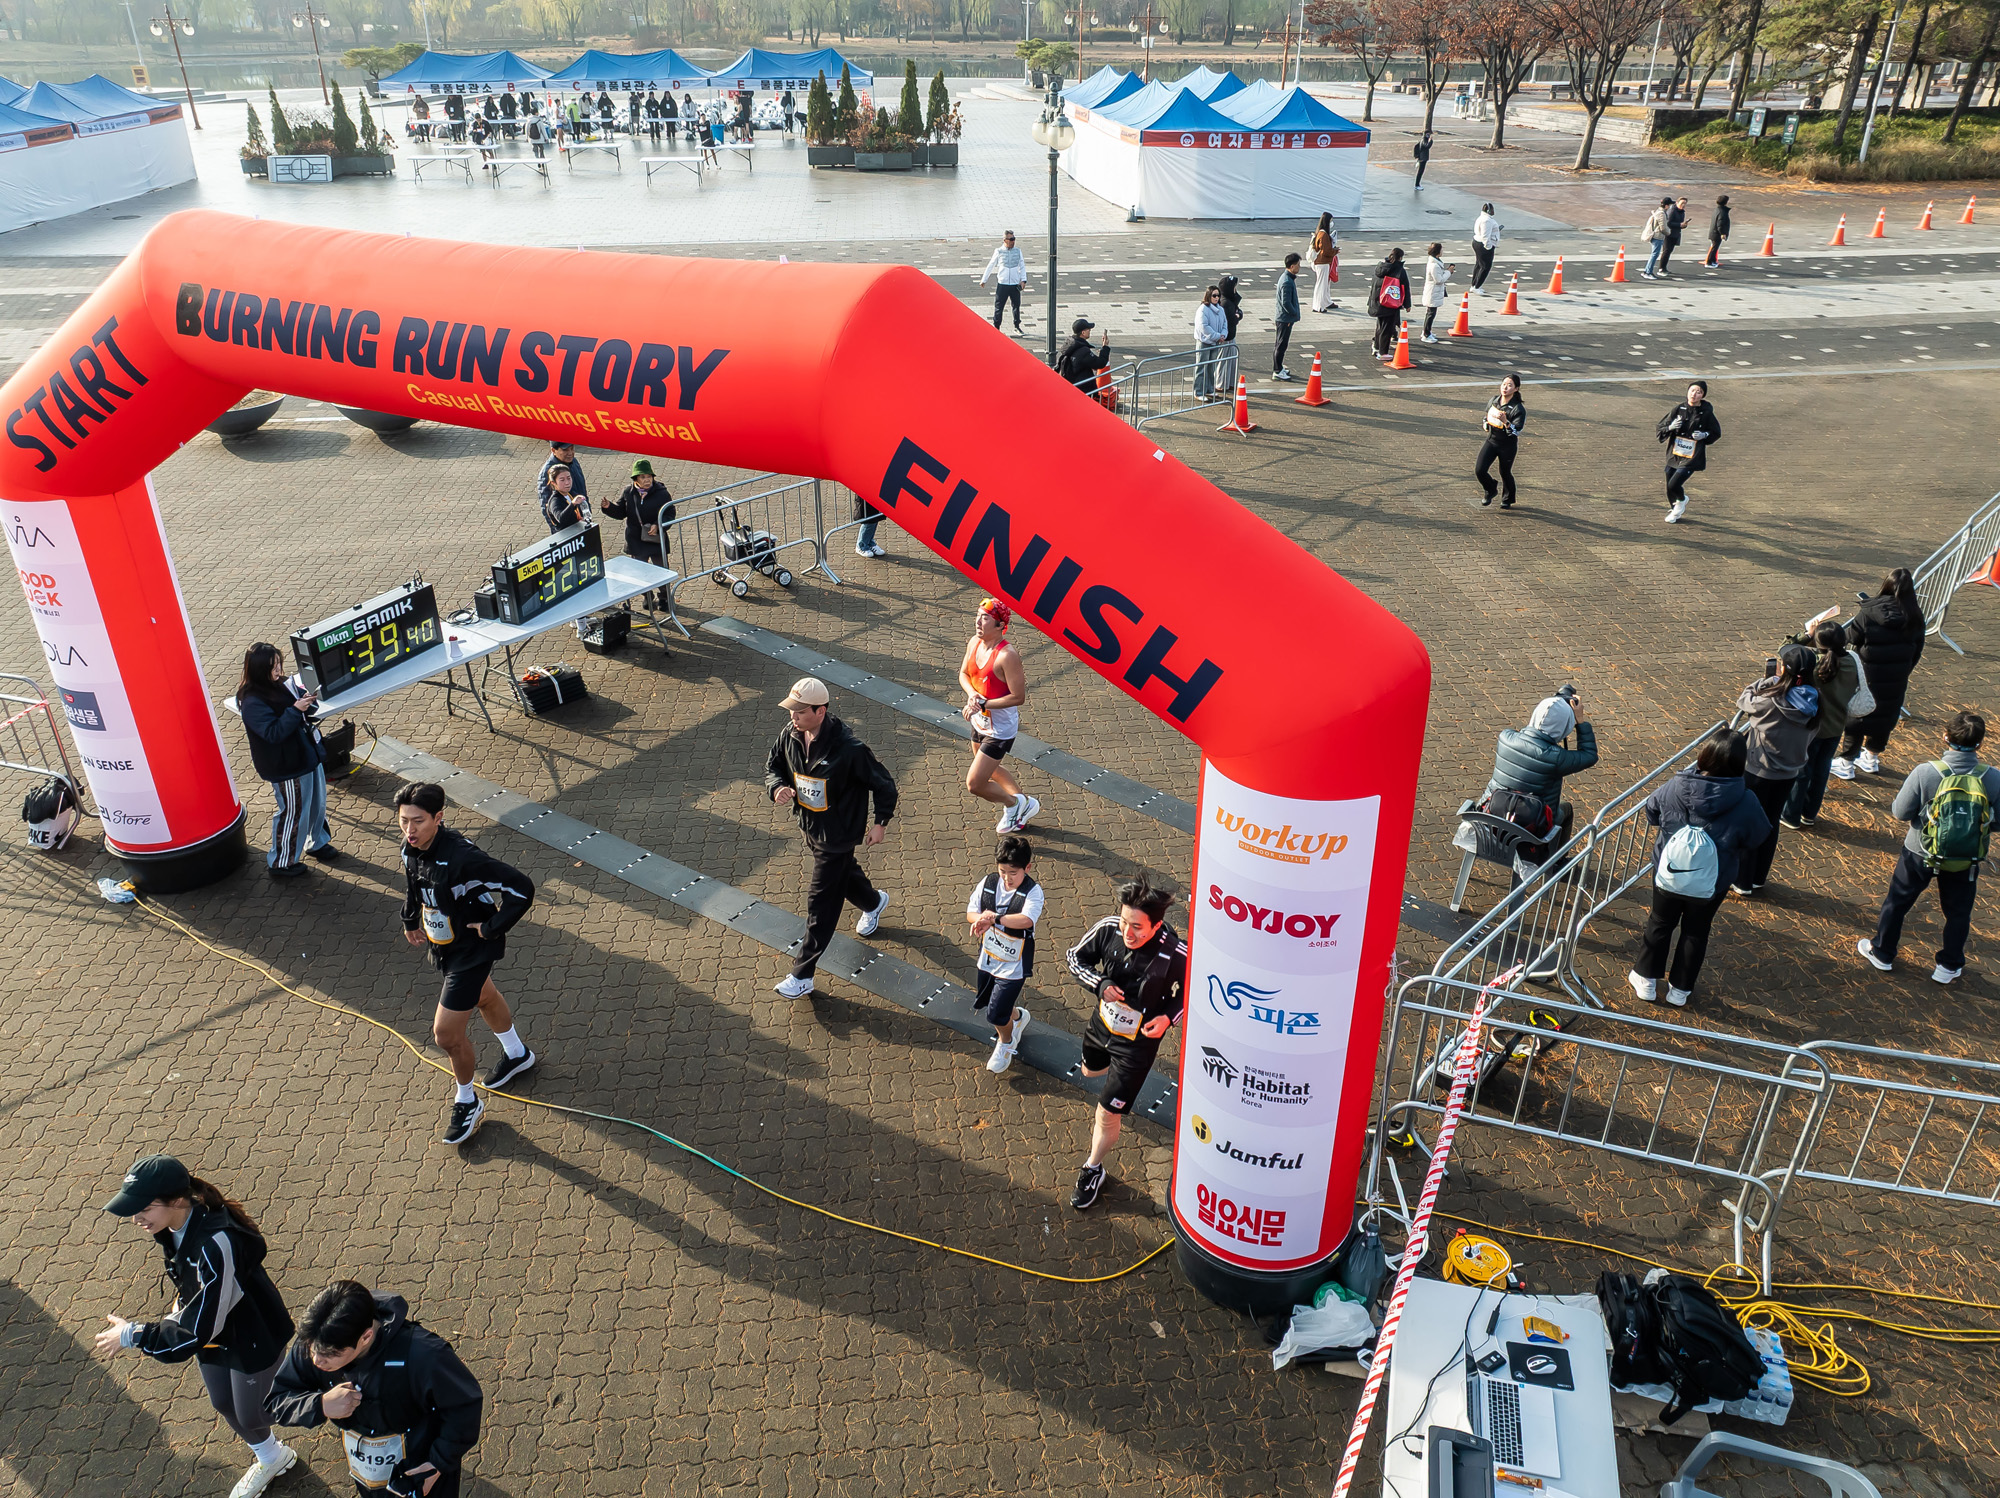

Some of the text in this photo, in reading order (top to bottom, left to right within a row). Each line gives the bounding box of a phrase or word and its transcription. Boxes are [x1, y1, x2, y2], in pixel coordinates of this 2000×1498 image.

[407, 82, 516, 94] A 물품보관소 B
[572, 80, 681, 92] C 물품보관소 D
[737, 80, 745, 89] E
[761, 79, 810, 91] 물품보관
[1208, 133, 1306, 149] 여자탈의실
[176, 282, 732, 412] BURNING RUN STORY
[6, 314, 150, 473] START
[406, 383, 703, 444] Casual Running Festival
[542, 535, 585, 568] SAMIK
[18, 568, 56, 588] OOD
[522, 563, 539, 578] 5km
[879, 436, 1225, 724] FINISH
[24, 588, 63, 607] UCK
[353, 597, 413, 637] SAMIK
[321, 629, 351, 648] 10km
[96, 759, 134, 771] SENSE
[798, 785, 821, 798] M5127
[113, 809, 152, 826] Store
[1215, 806, 1349, 861] workup
[1239, 842, 1309, 864] OUTDOOR OUTLET
[1208, 884, 1342, 939] SOYJOY
[1307, 940, 1338, 948] 소이조이
[1248, 1004, 1322, 1036] 피죤
[1244, 1065, 1286, 1080] 한국해비타트
[1242, 1073, 1311, 1096] Habitat
[1241, 1097, 1263, 1109] Korea
[1242, 1088, 1309, 1106] for Humanity
[1215, 1140, 1304, 1170] Jamful
[1196, 1183, 1287, 1247] 일요신문
